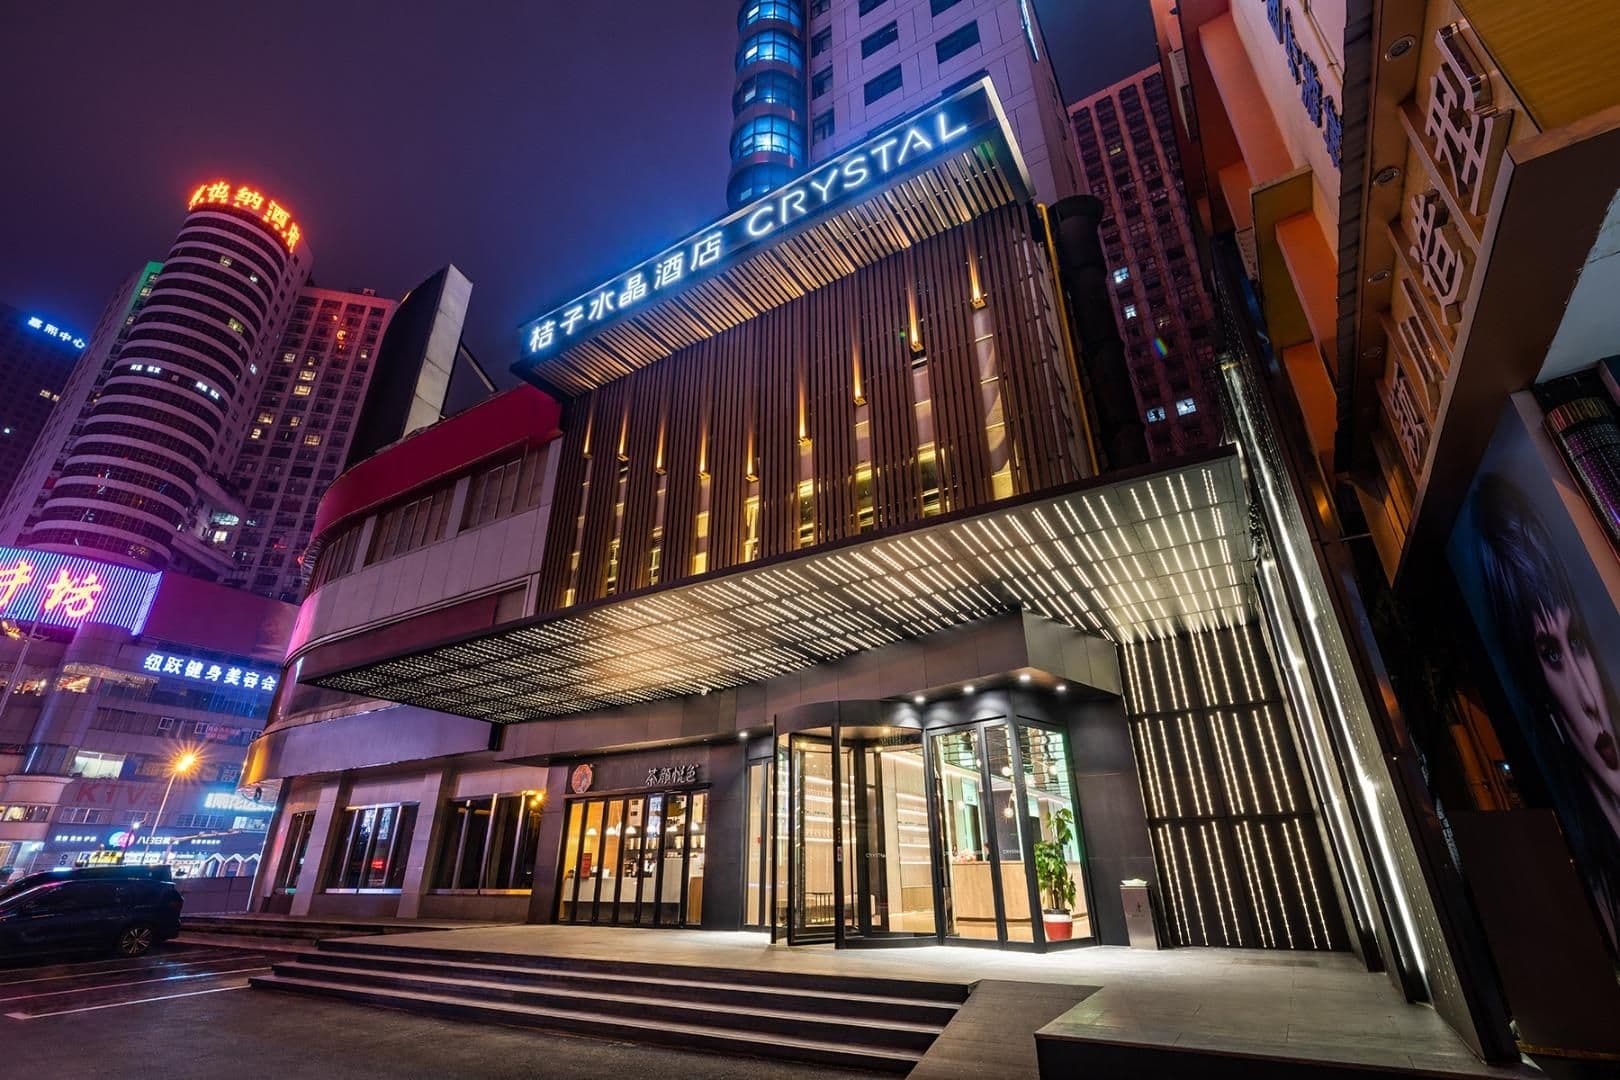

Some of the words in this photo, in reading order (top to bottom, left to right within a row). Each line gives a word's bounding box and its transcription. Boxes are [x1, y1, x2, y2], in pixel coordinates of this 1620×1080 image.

[528, 231, 723, 352] 桔子水晶酒店
[746, 112, 968, 237] CRYSTAL
[143, 652, 277, 691] 纽跃健身美容会
[77, 783, 146, 804] KTV
